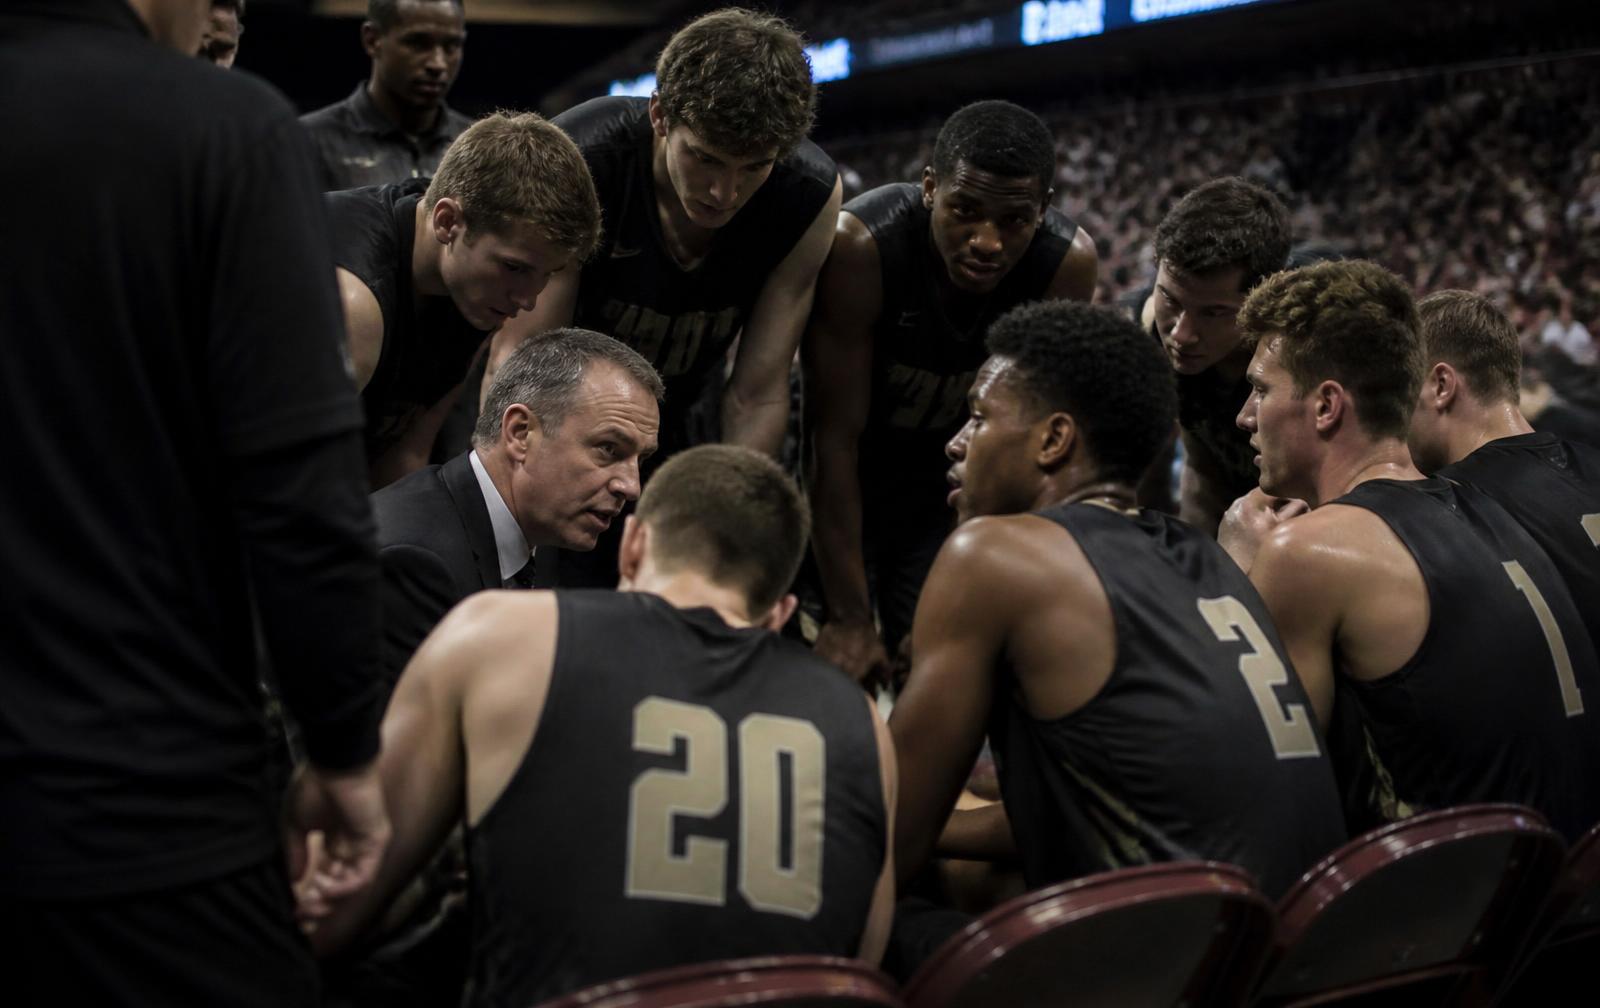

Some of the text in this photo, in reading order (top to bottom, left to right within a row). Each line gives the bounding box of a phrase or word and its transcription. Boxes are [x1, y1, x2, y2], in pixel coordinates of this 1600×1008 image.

[1196, 595, 1321, 760] 2
[1501, 559, 1584, 718] 1
[624, 695, 826, 920] 20
